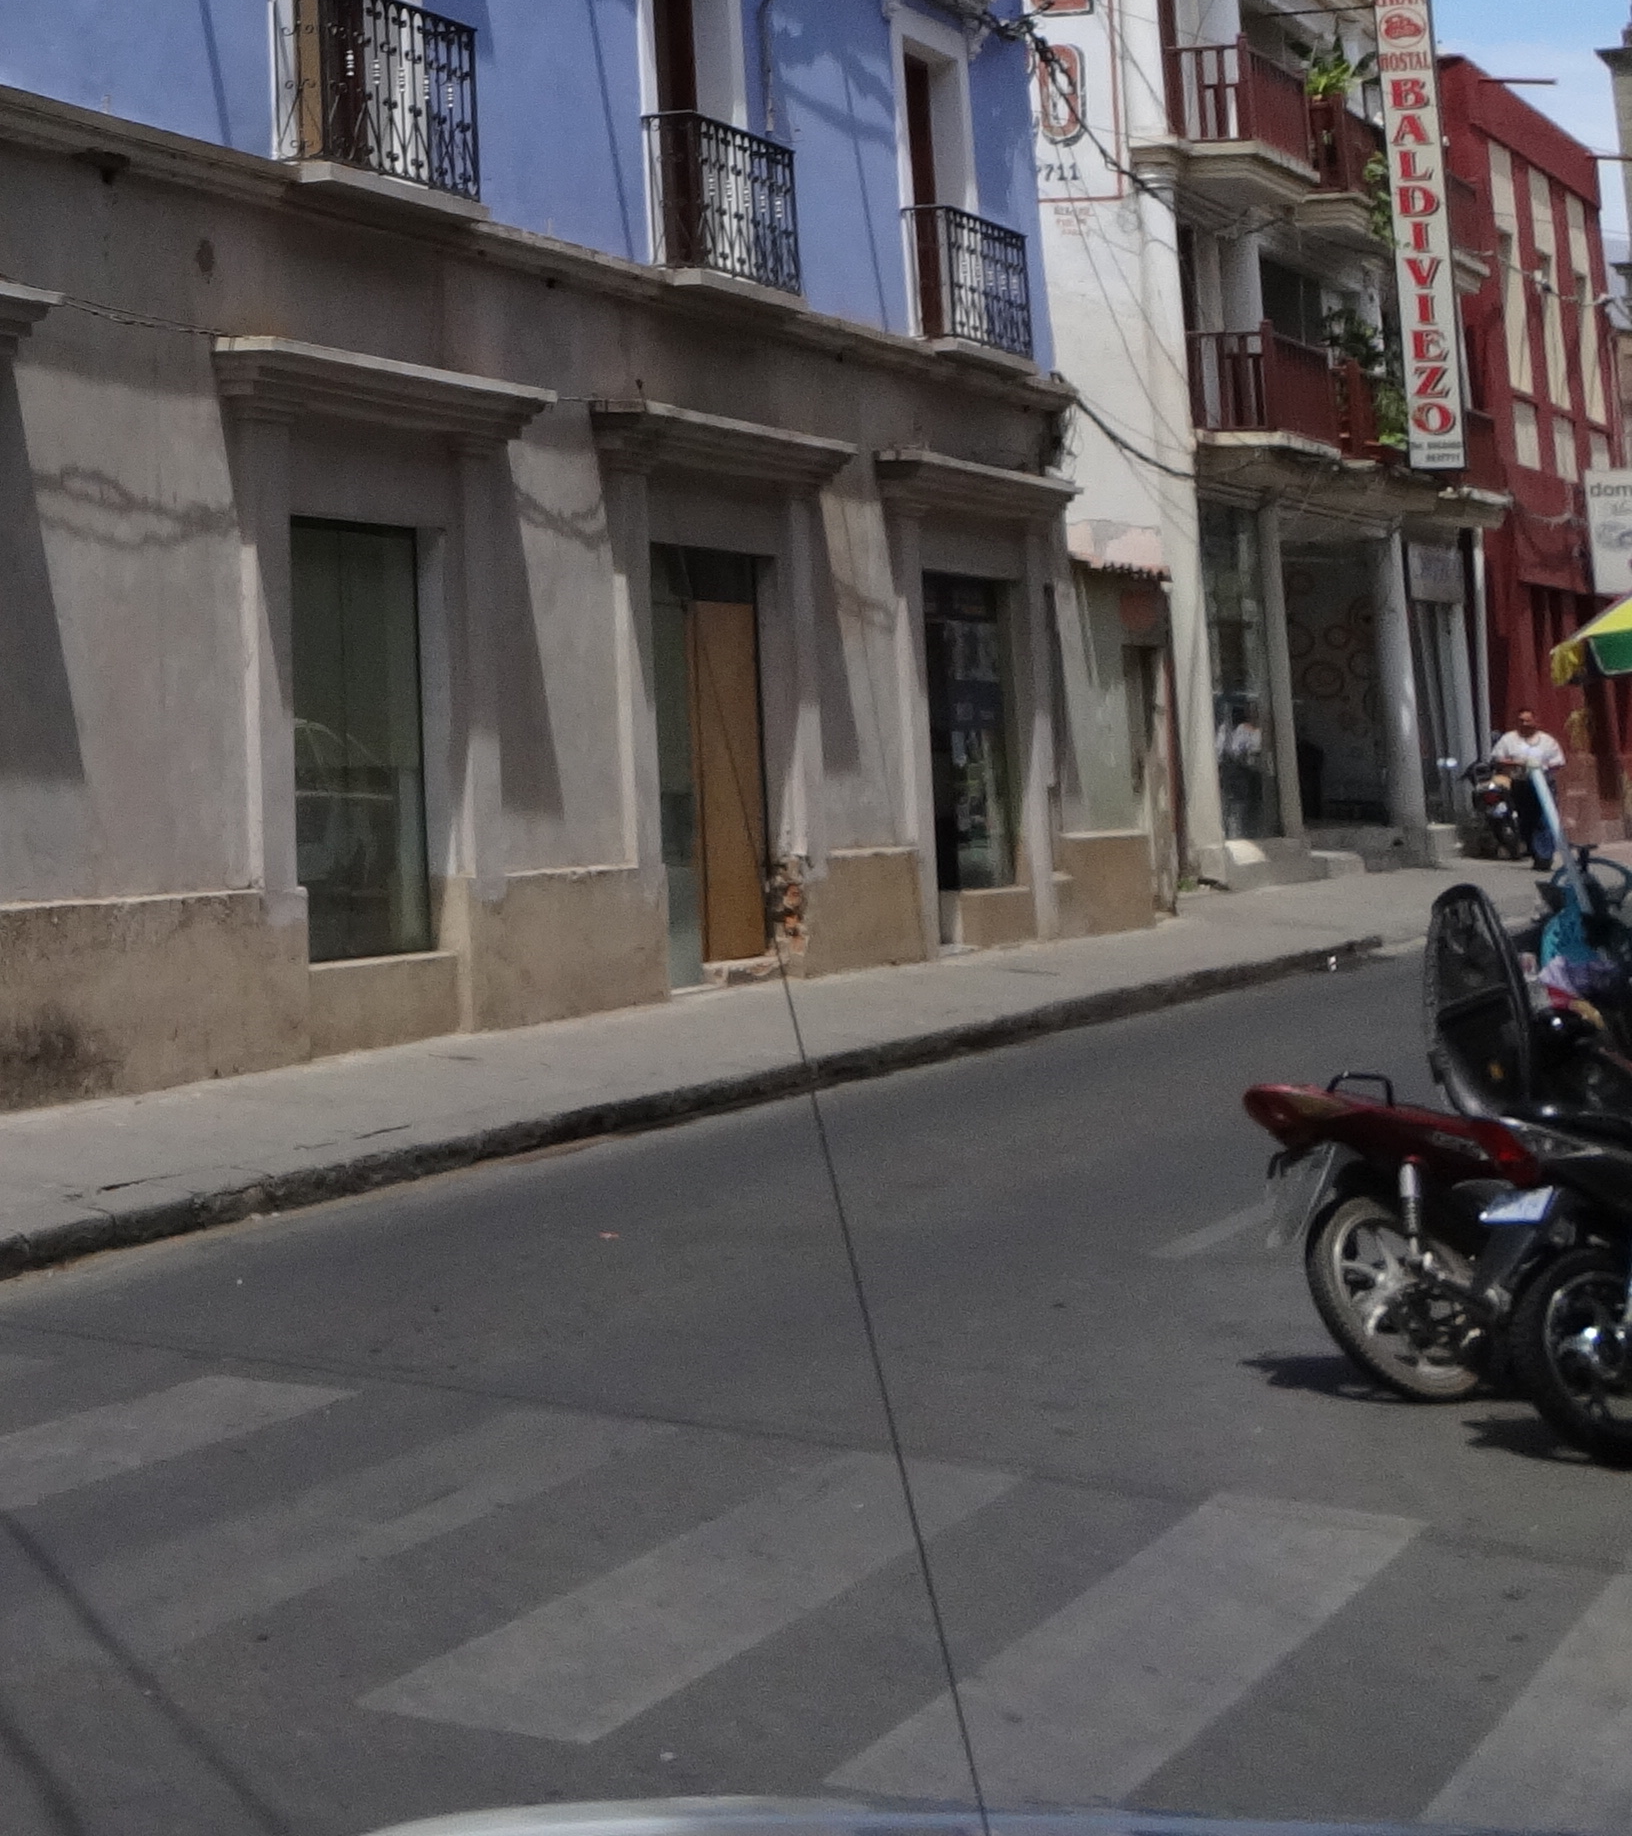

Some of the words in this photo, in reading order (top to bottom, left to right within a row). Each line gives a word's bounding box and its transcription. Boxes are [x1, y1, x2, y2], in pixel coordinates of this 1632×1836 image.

[1379, 51, 1431, 71] HOSTAL
[1036, 162, 1080, 182] 711
[1390, 77, 1456, 435] BALDIVIEZO
